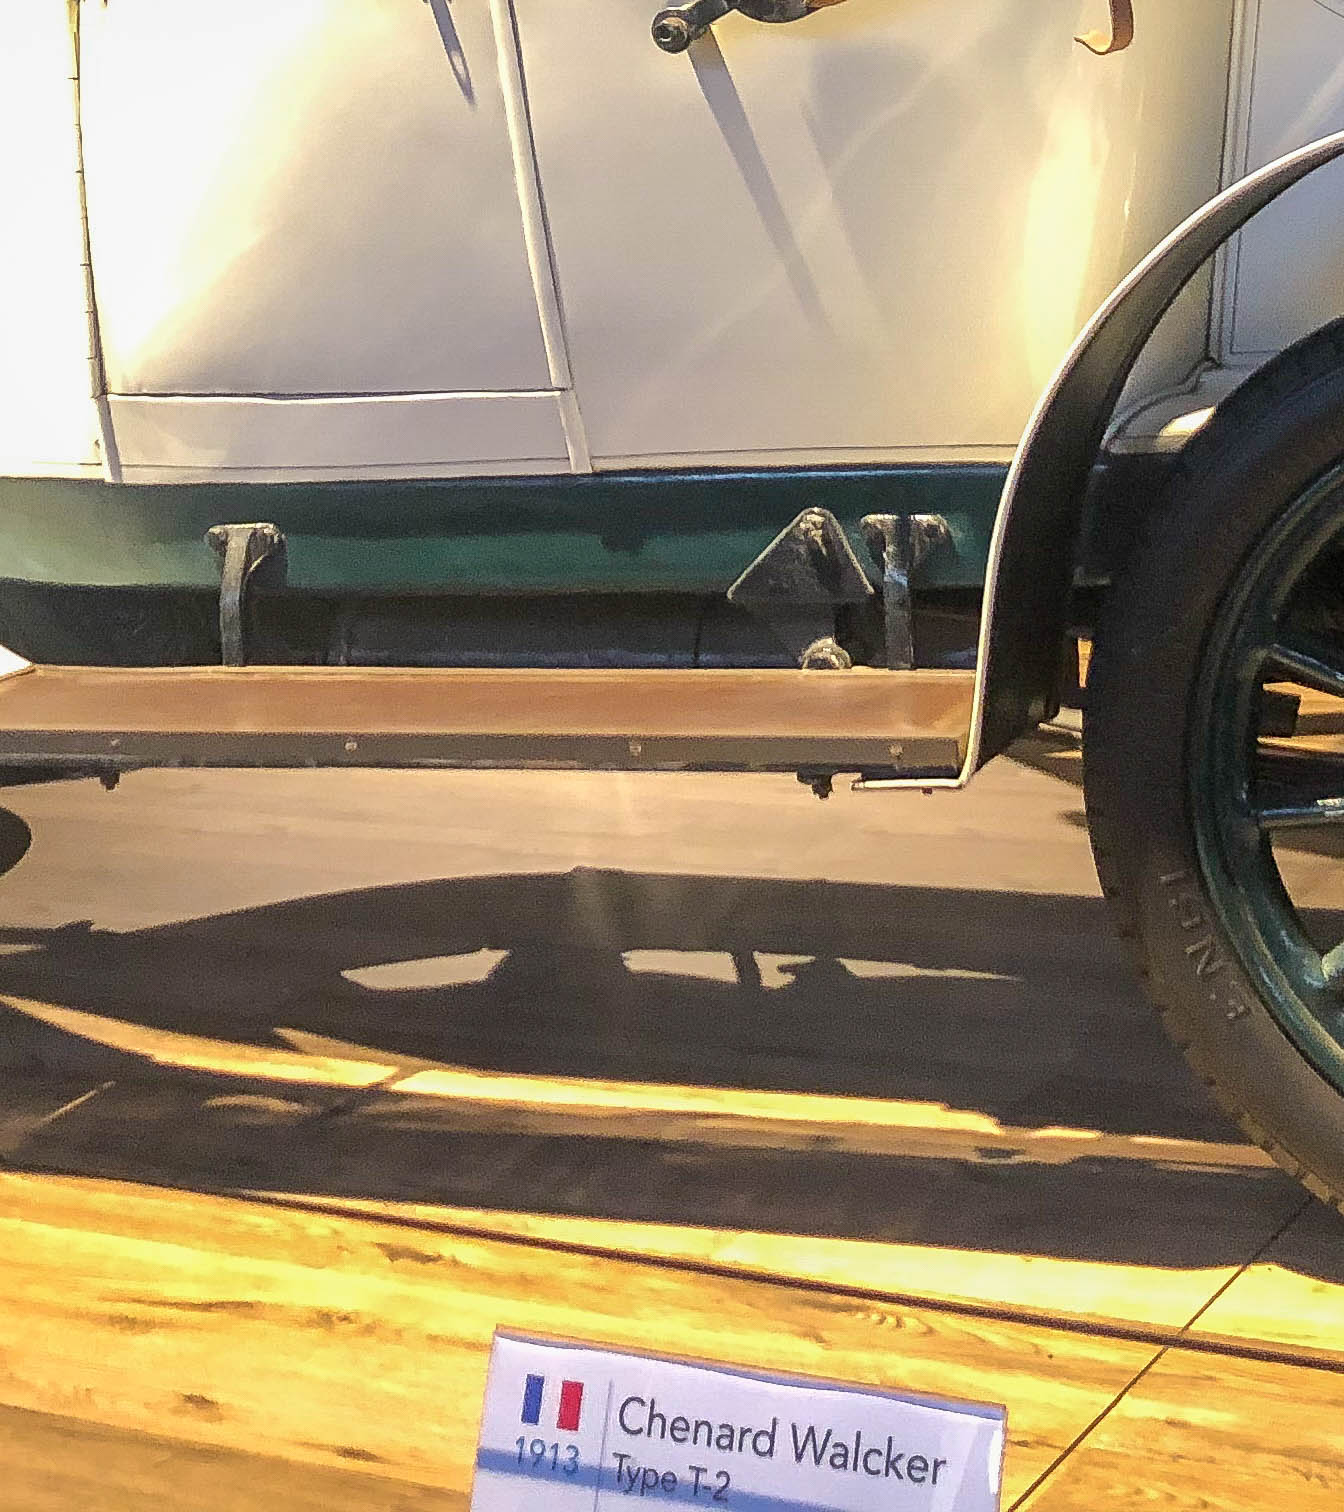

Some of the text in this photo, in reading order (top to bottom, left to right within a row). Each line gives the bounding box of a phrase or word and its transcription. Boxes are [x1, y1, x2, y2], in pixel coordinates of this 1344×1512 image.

[514, 1435, 581, 1475] 1913
[617, 1396, 947, 1485] Chenard Walcker
[612, 1452, 732, 1502] Type T-2
